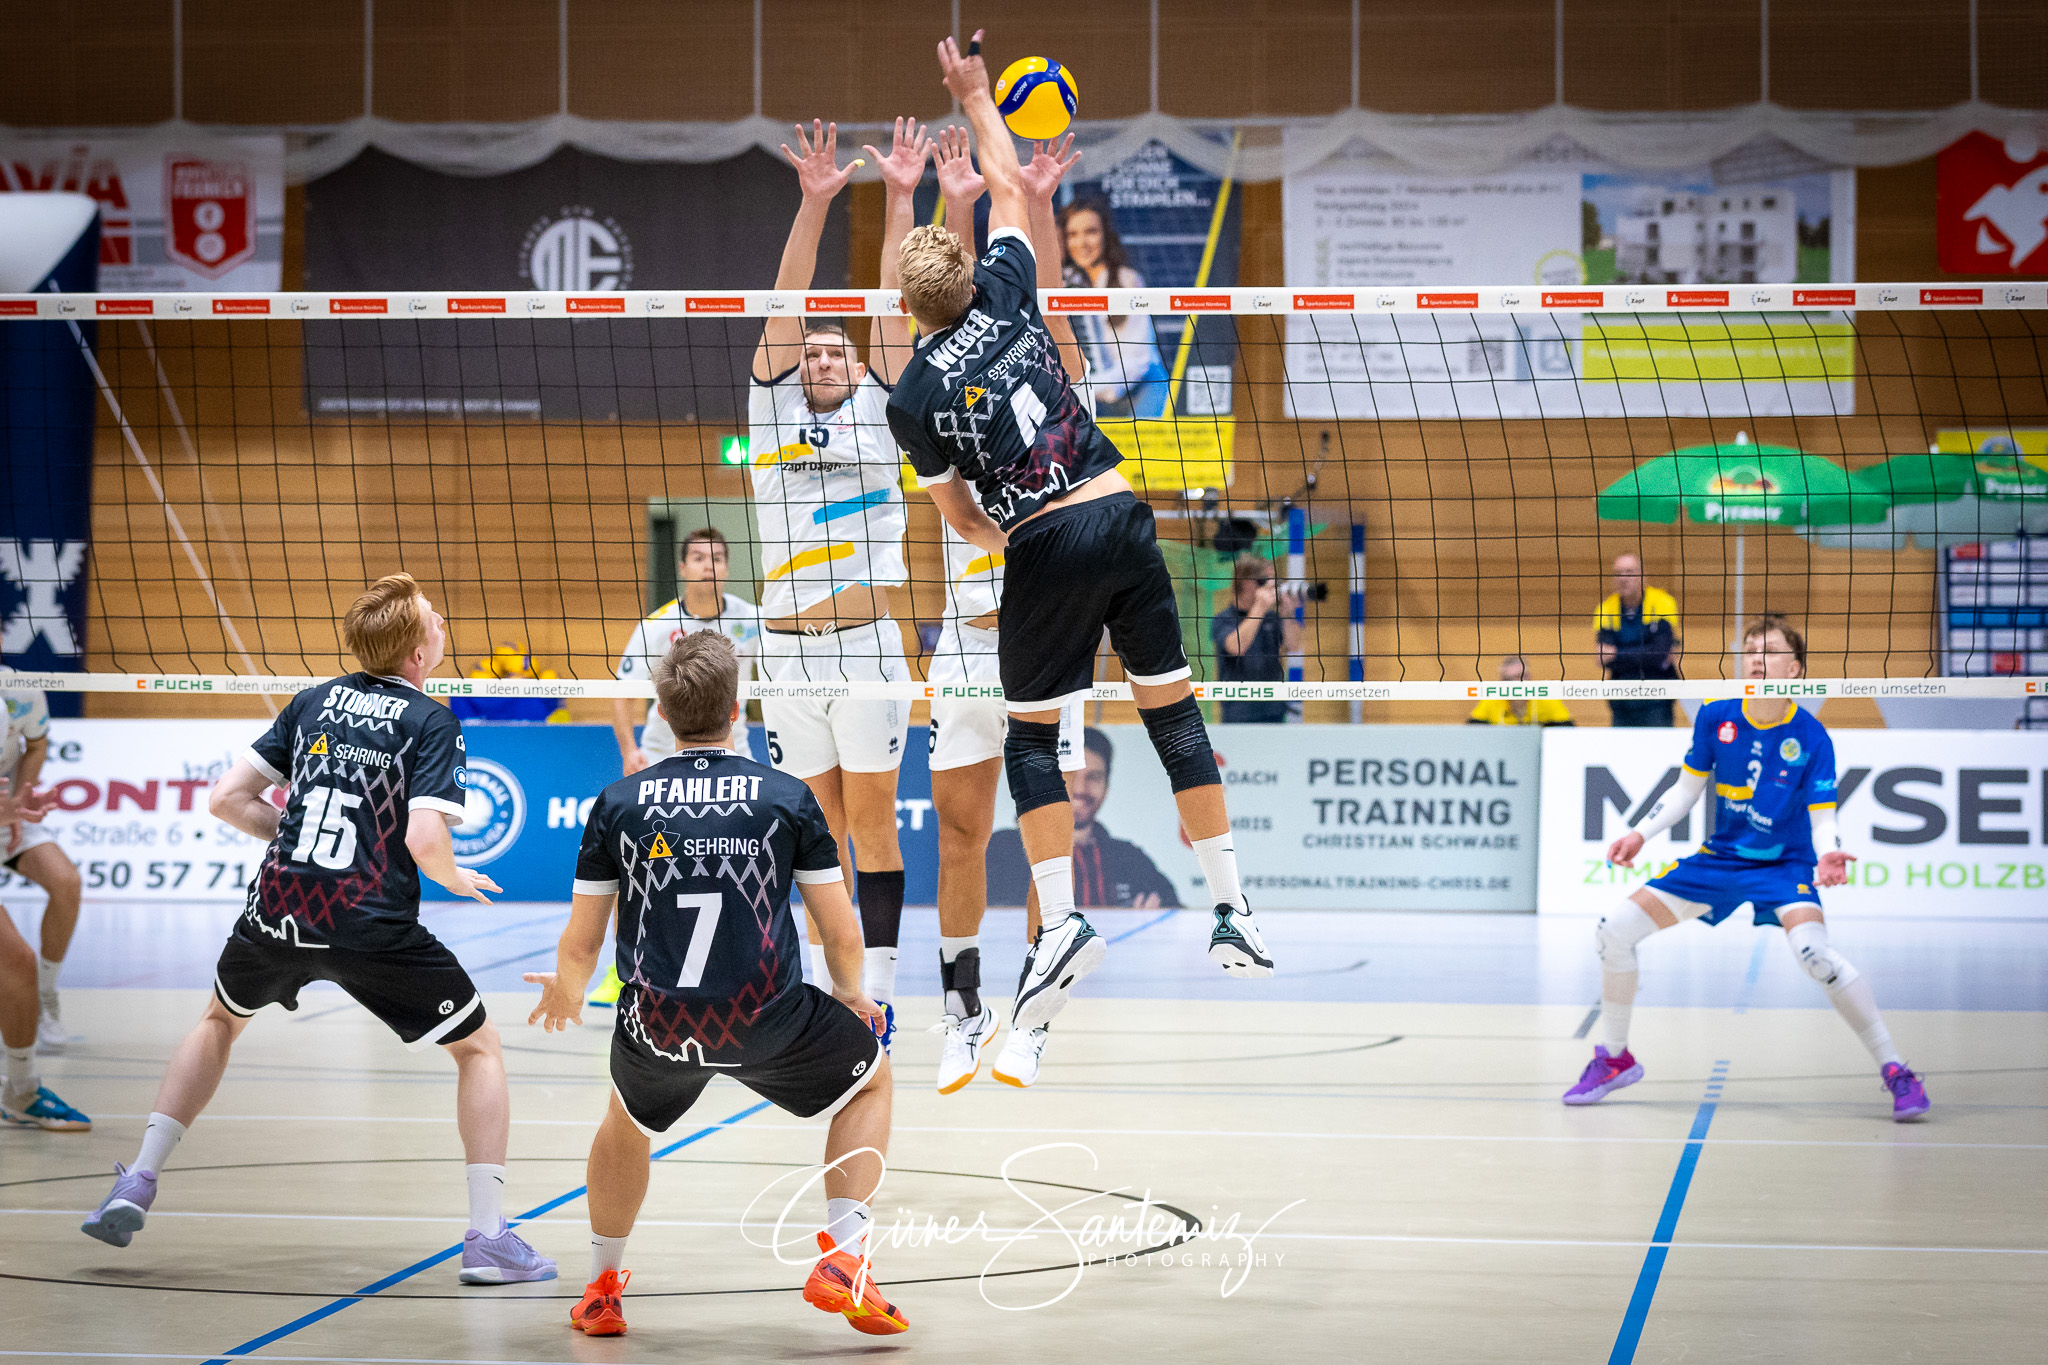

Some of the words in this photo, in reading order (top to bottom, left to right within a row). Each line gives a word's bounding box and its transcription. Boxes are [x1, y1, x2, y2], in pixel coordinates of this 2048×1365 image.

[926, 309, 994, 371] WEBER
[987, 331, 1037, 381] SEHRING
[5, 678, 65, 689] umsetzen
[154, 680, 213, 691] FUCHS
[225, 680, 260, 692] Ideen
[262, 681, 320, 692] umsetze
[425, 683, 473, 694] UCHS
[486, 683, 519, 695] Ideen
[523, 684, 585, 695] umsetzen
[750, 686, 784, 697] Ideen
[788, 686, 849, 697] umsetzen
[942, 687, 1003, 697] FUCHS
[1212, 687, 1274, 698] FUCHS
[1288, 686, 1322, 698] Ideen
[1327, 687, 1390, 698] umsetzen
[1486, 686, 1549, 697] FUCHS
[1562, 685, 1598, 697] Ideen
[1602, 686, 1666, 697] umsetzen
[1764, 684, 1827, 695] FUCHS
[1841, 683, 1877, 694] Ideen
[1882, 683, 1946, 694] umsetzen
[323, 685, 410, 721] STOHNER
[334, 743, 392, 770] SEHRING
[1226, 771, 1279, 785] OACH
[1308, 759, 1518, 787] PERSONAL
[638, 775, 763, 805] PFAHLERT
[1312, 798, 1511, 826] TRAINING
[72, 821, 158, 846] Straße
[167, 822, 183, 846] 6
[291, 786, 363, 870] 15
[683, 837, 759, 857] SEHRING
[1303, 834, 1414, 849] CHRISTIAN
[1420, 834, 1520, 849] SCHWADE
[145, 861, 191, 888] 57
[207, 861, 246, 888] 71
[1907, 862, 2046, 888] HOLZB
[676, 893, 722, 987] 7
